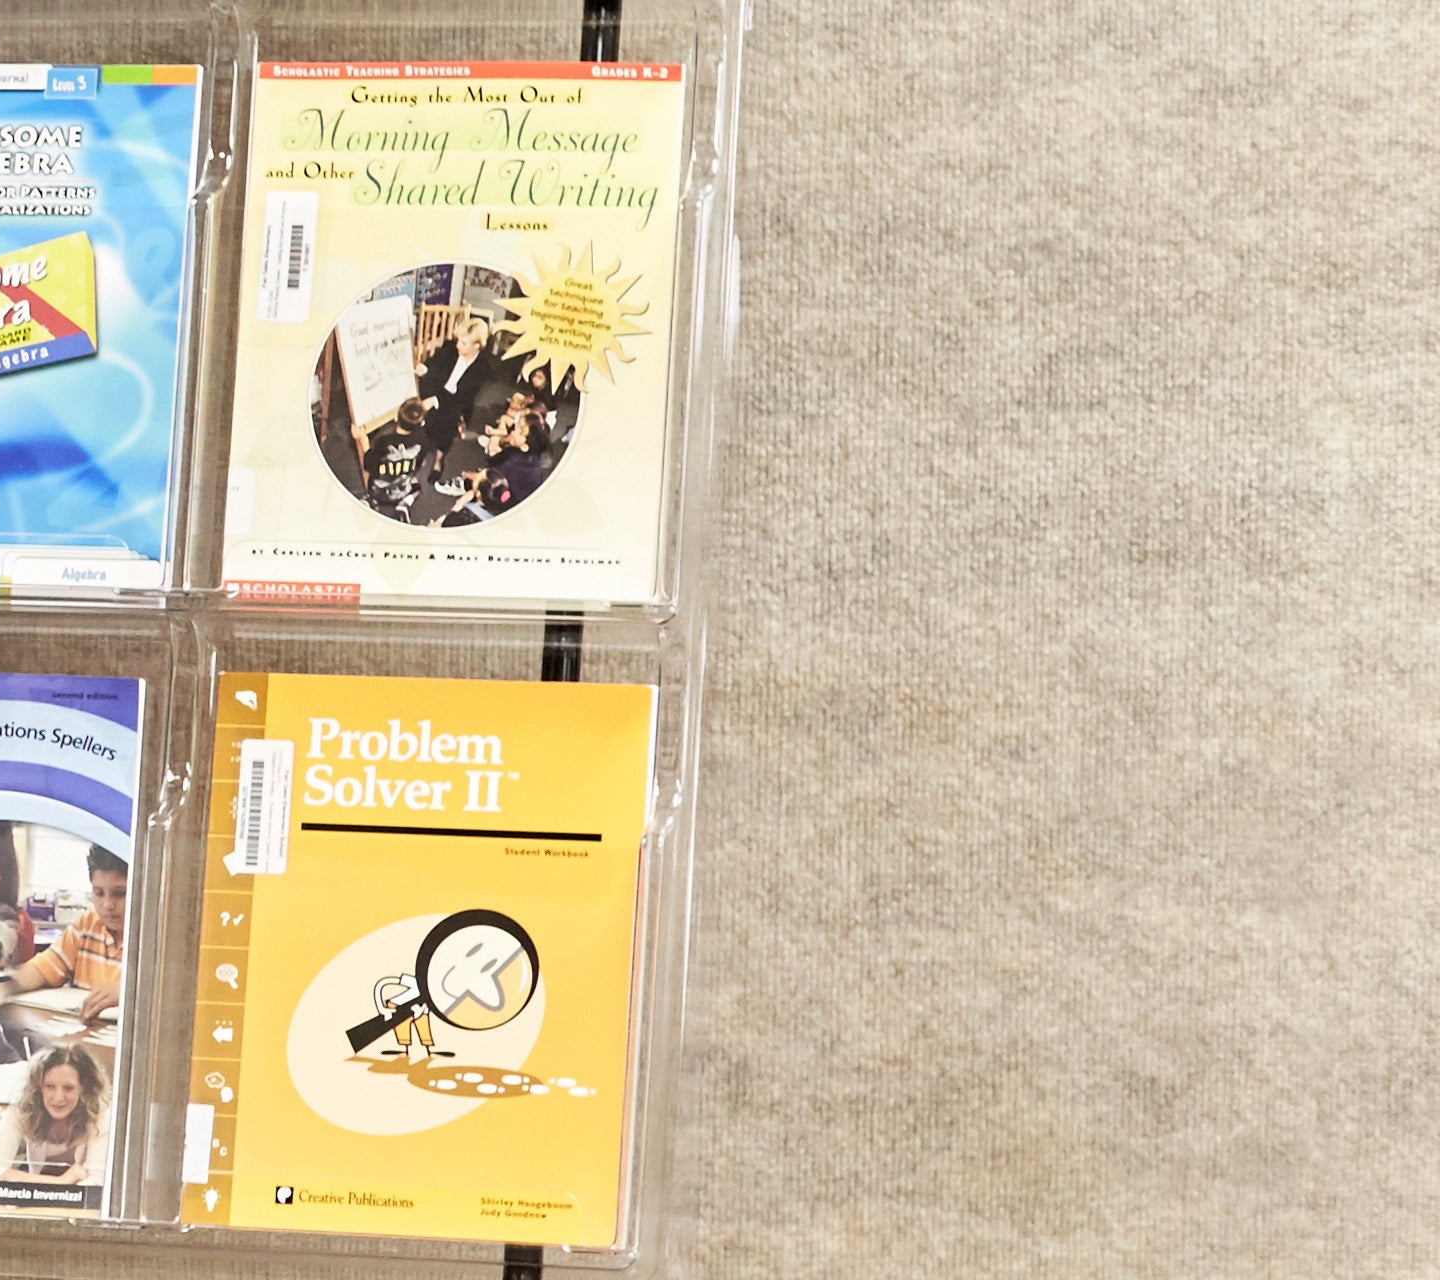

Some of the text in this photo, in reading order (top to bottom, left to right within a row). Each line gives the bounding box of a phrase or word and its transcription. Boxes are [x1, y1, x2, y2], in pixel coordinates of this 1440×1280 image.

[273, 65, 471, 77] SCHOLASTIC TEACHING STRATEGIES
[592, 66, 668, 79] GRADES K-2
[351, 86, 583, 107] Getting the Most Out of
[283, 107, 639, 177] Morning Message
[21, 185, 96, 199] PATTERNS
[266, 159, 661, 232] and Other Shared Writing
[486, 214, 548, 232] Lessons
[62, 567, 106, 582] Algebra
[50, 727, 117, 762] Spellers
[306, 717, 503, 765] Problem
[303, 763, 502, 812] Solver II
[298, 1190, 414, 1209] Creative Publications
